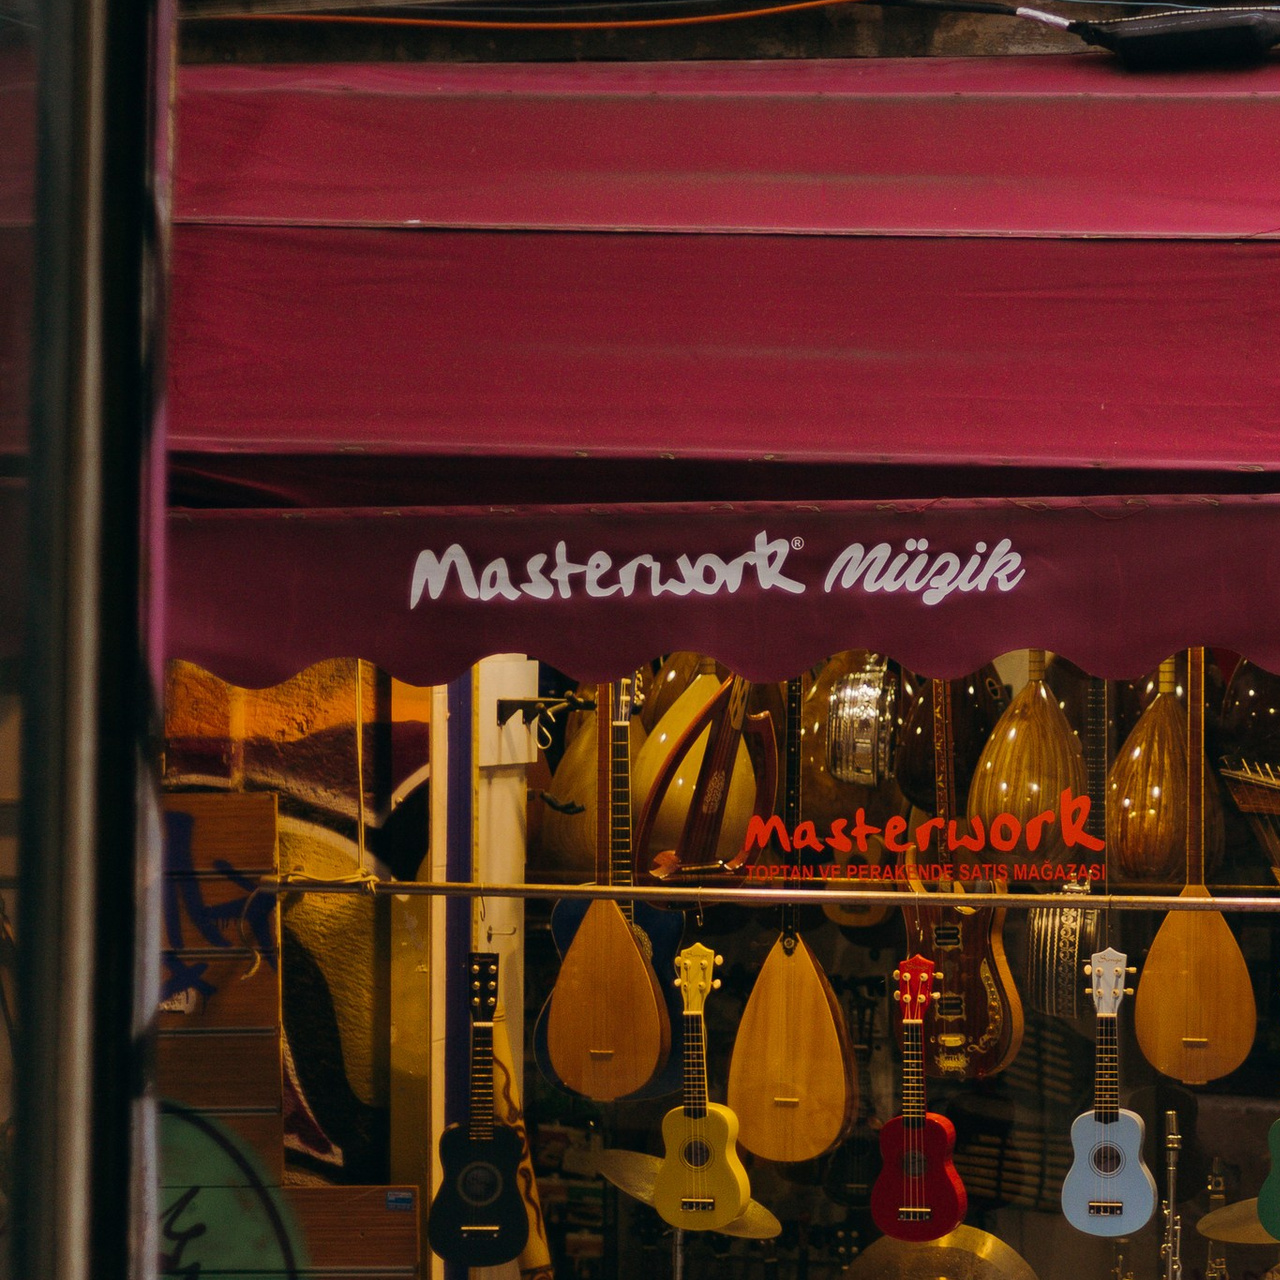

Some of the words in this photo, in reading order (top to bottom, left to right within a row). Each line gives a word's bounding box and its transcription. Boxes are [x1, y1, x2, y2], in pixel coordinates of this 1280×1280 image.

[825, 537, 1025, 605] Müzik
[745, 787, 1106, 853] Masterwork
[746, 864, 813, 881] TOPTAN
[847, 864, 953, 881] PERAKENDE
[1014, 859, 1105, 881] MAĞAZASI
